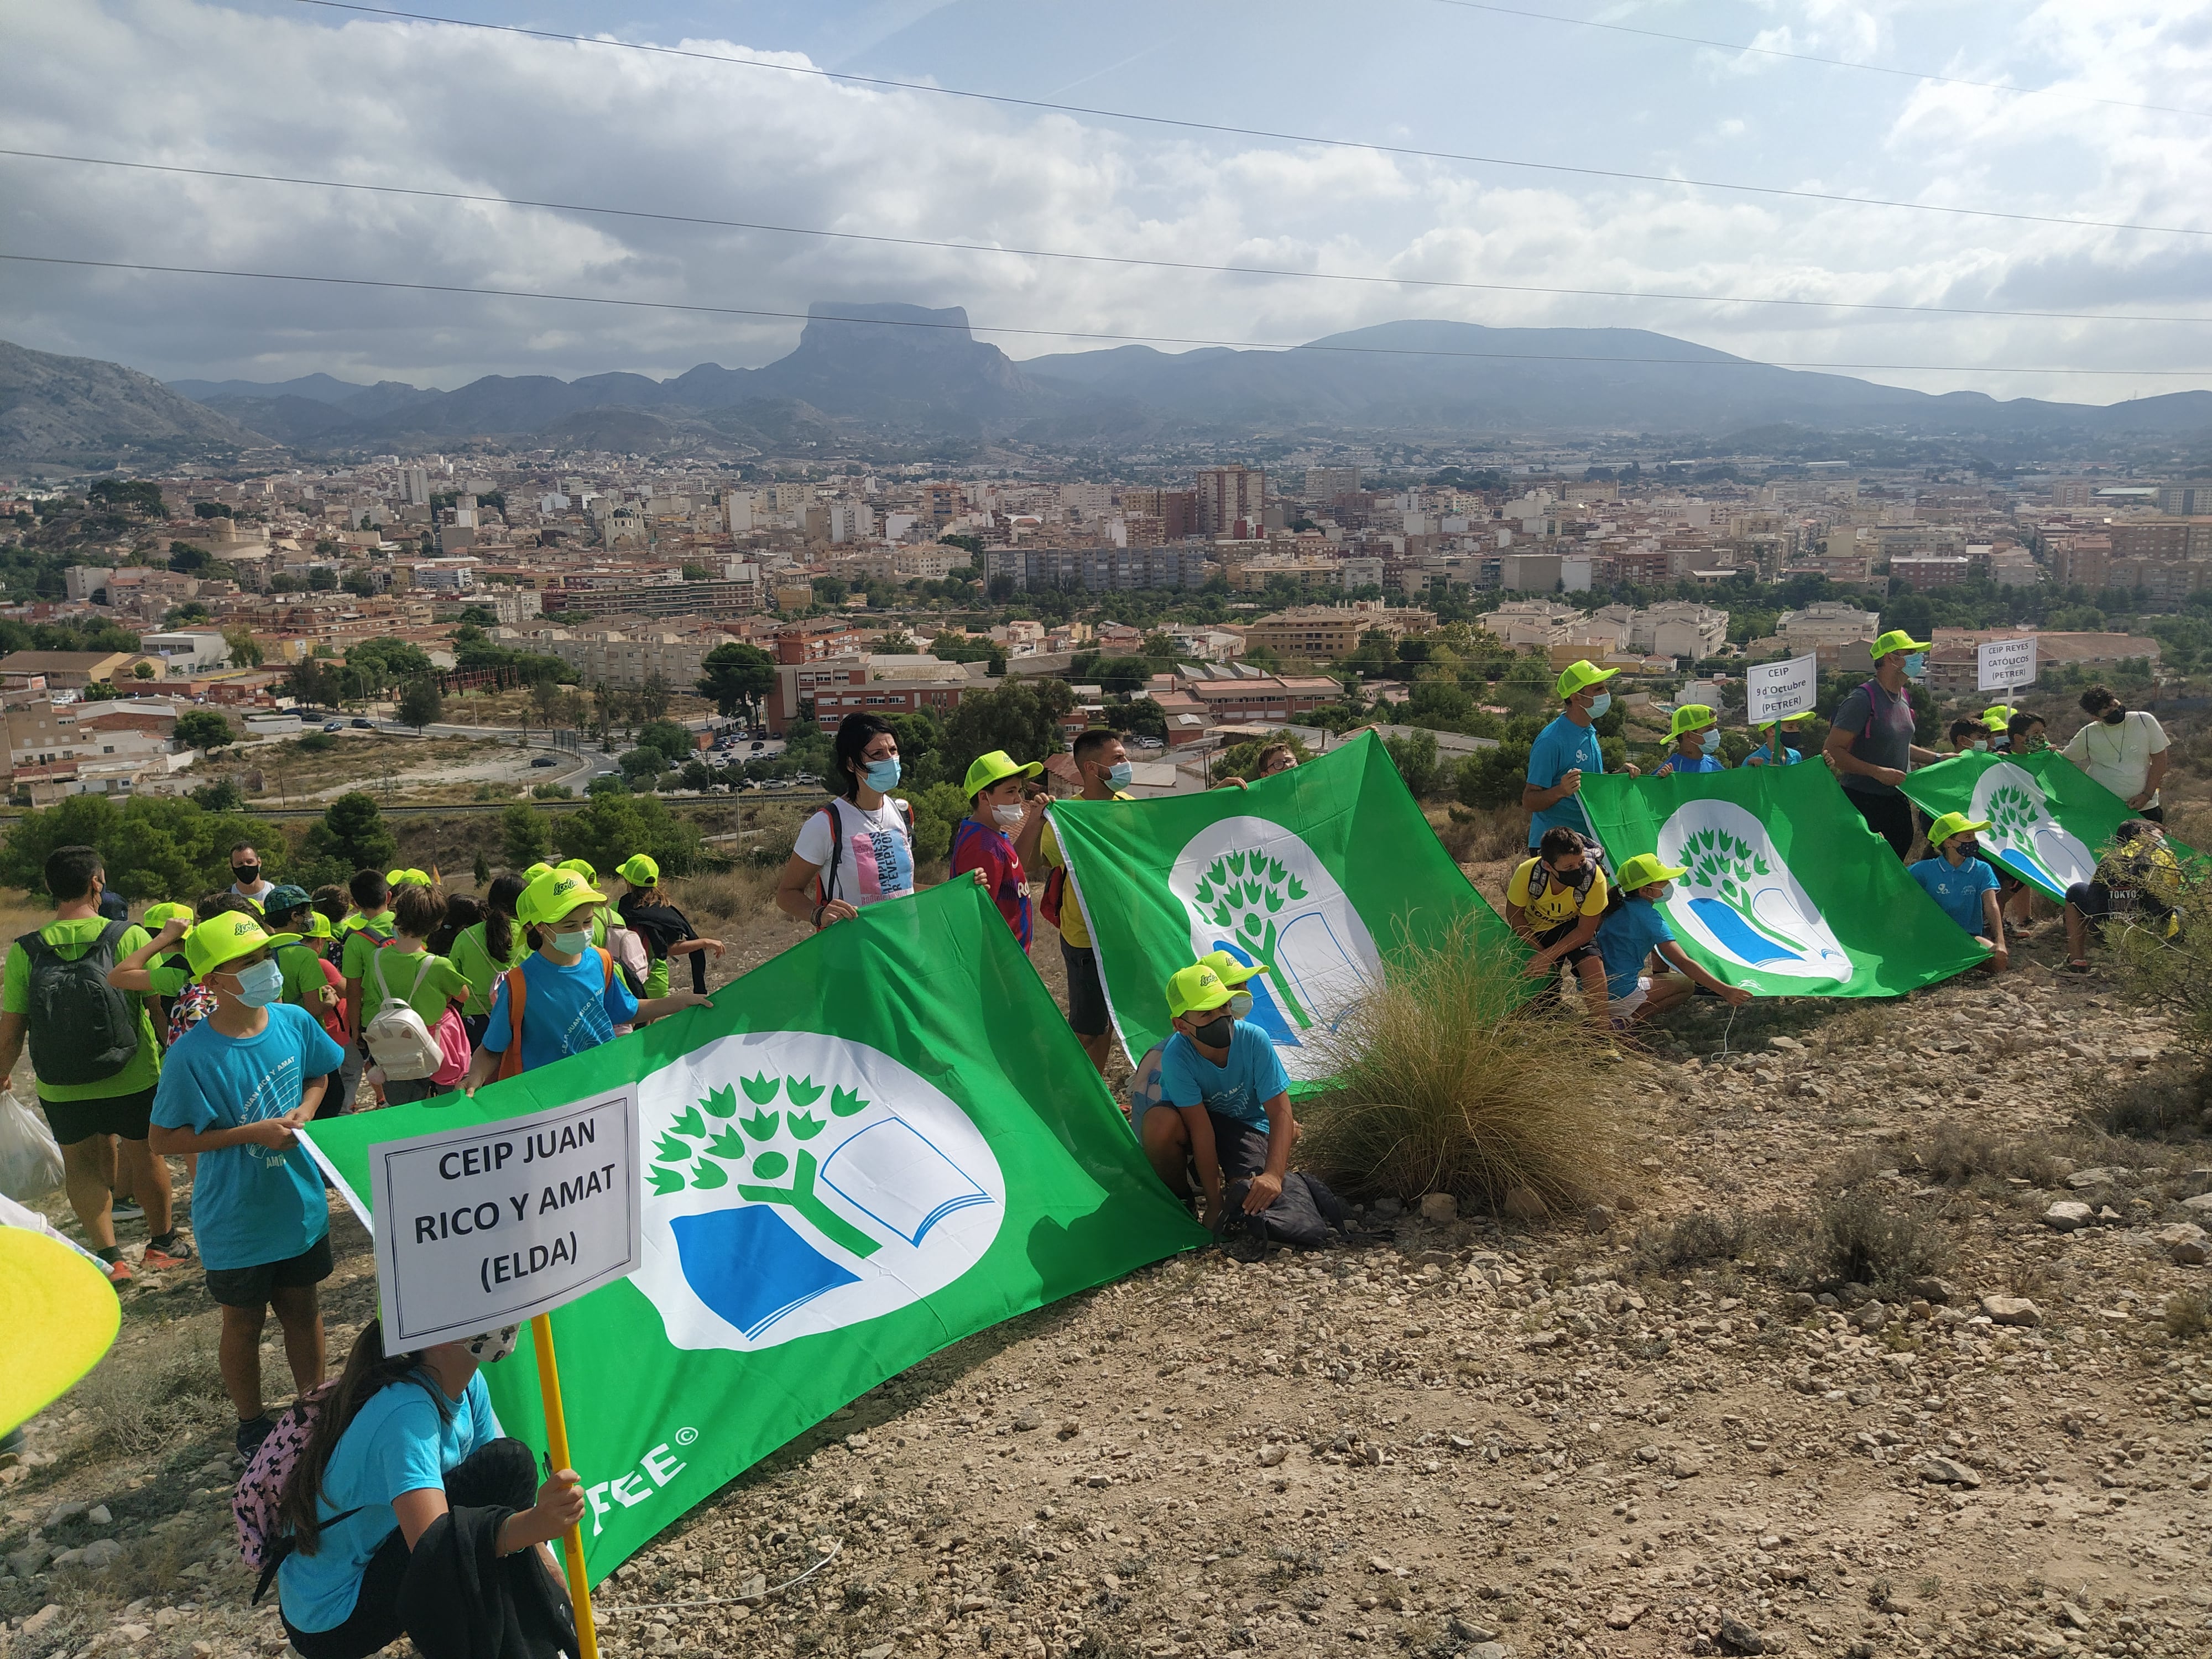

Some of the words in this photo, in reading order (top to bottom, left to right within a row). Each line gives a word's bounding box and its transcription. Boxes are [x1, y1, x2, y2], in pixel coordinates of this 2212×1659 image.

[1989, 646, 2004, 654] CEIP
[2006, 643, 2028, 652] REYES
[1988, 656, 2029, 667] CATÓLICOS
[1768, 667, 1789, 677] CEIP
[1992, 668, 2026, 681] (PETRER)
[1756, 688, 1761, 696] 9
[1762, 695, 1802, 714] (PETRER)
[567, 1016, 581, 1034] JUAN
[579, 1002, 591, 1017] RICO
[244, 1091, 259, 1112] JUAN
[257, 1074, 271, 1092] RICO
[278, 1056, 295, 1071] AMAT
[439, 1142, 513, 1180] CEIP
[523, 1118, 595, 1164] JUAN
[415, 1202, 500, 1244] RICO
[509, 1193, 529, 1222] Y
[539, 1163, 615, 1215] AMAT
[480, 1231, 577, 1293] (ELDA)
